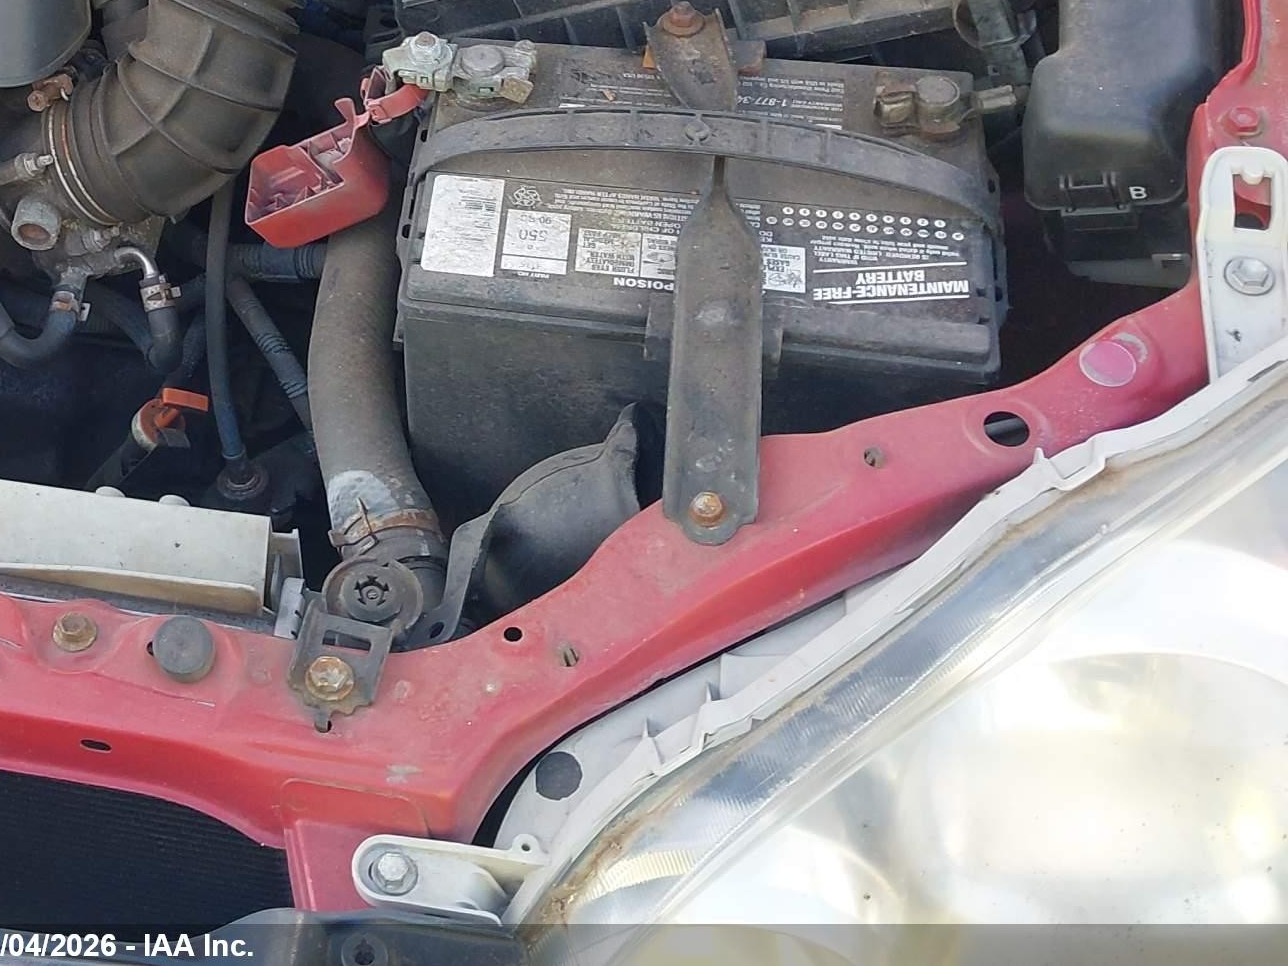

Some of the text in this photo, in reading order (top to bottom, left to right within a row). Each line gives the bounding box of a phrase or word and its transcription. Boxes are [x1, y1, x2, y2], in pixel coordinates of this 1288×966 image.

[737, 95, 788, 107] 1-877-34
[1129, 186, 1147, 199] B
[766, 258, 790, 266] GASES
[613, 277, 674, 290] POISON
[855, 269, 925, 285] BATTERY
[813, 280, 969, 301] MAINTENANCE-FREE
